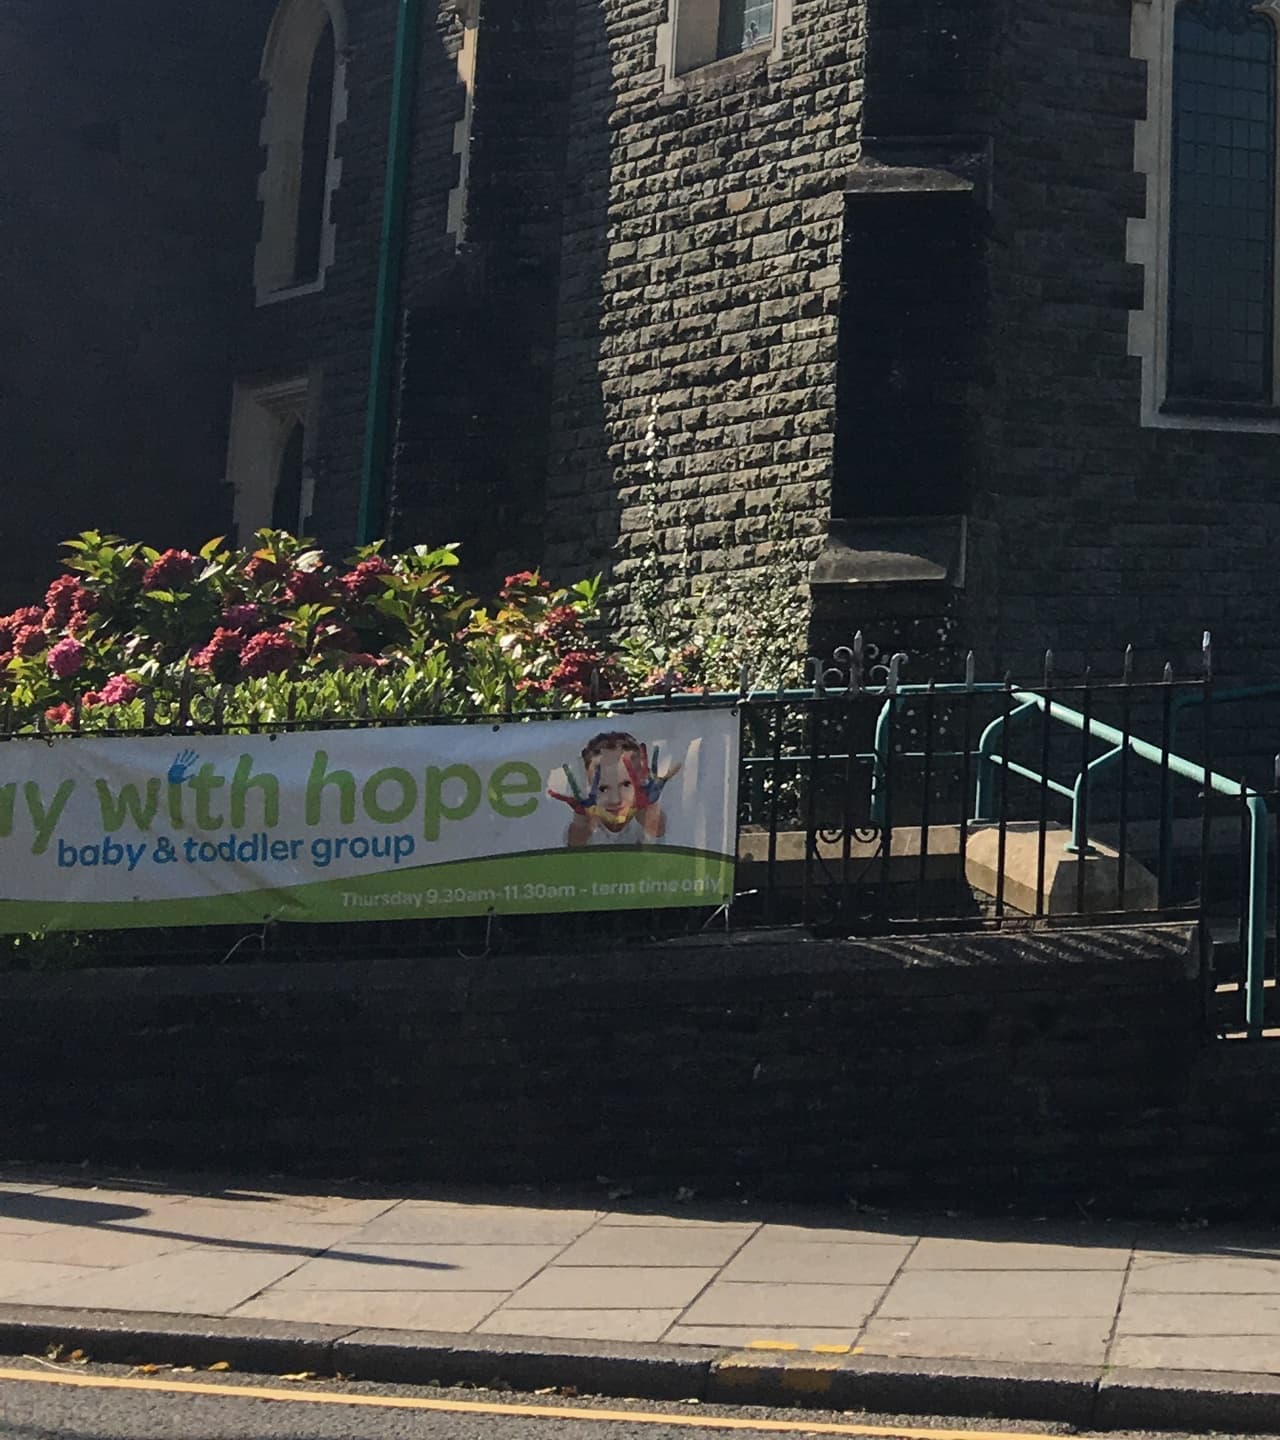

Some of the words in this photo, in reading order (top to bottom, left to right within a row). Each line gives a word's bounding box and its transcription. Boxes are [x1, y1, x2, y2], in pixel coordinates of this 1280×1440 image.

[0, 779, 75, 855] y
[96, 750, 279, 832] with
[305, 750, 542, 842] hope
[57, 836, 147, 870] baby
[152, 836, 178, 864] &
[183, 832, 304, 865] toddler
[311, 833, 416, 868] group
[341, 889, 422, 909] Thursday
[592, 877, 635, 897] term
[639, 876, 678, 895] time
[681, 874, 722, 894] only
